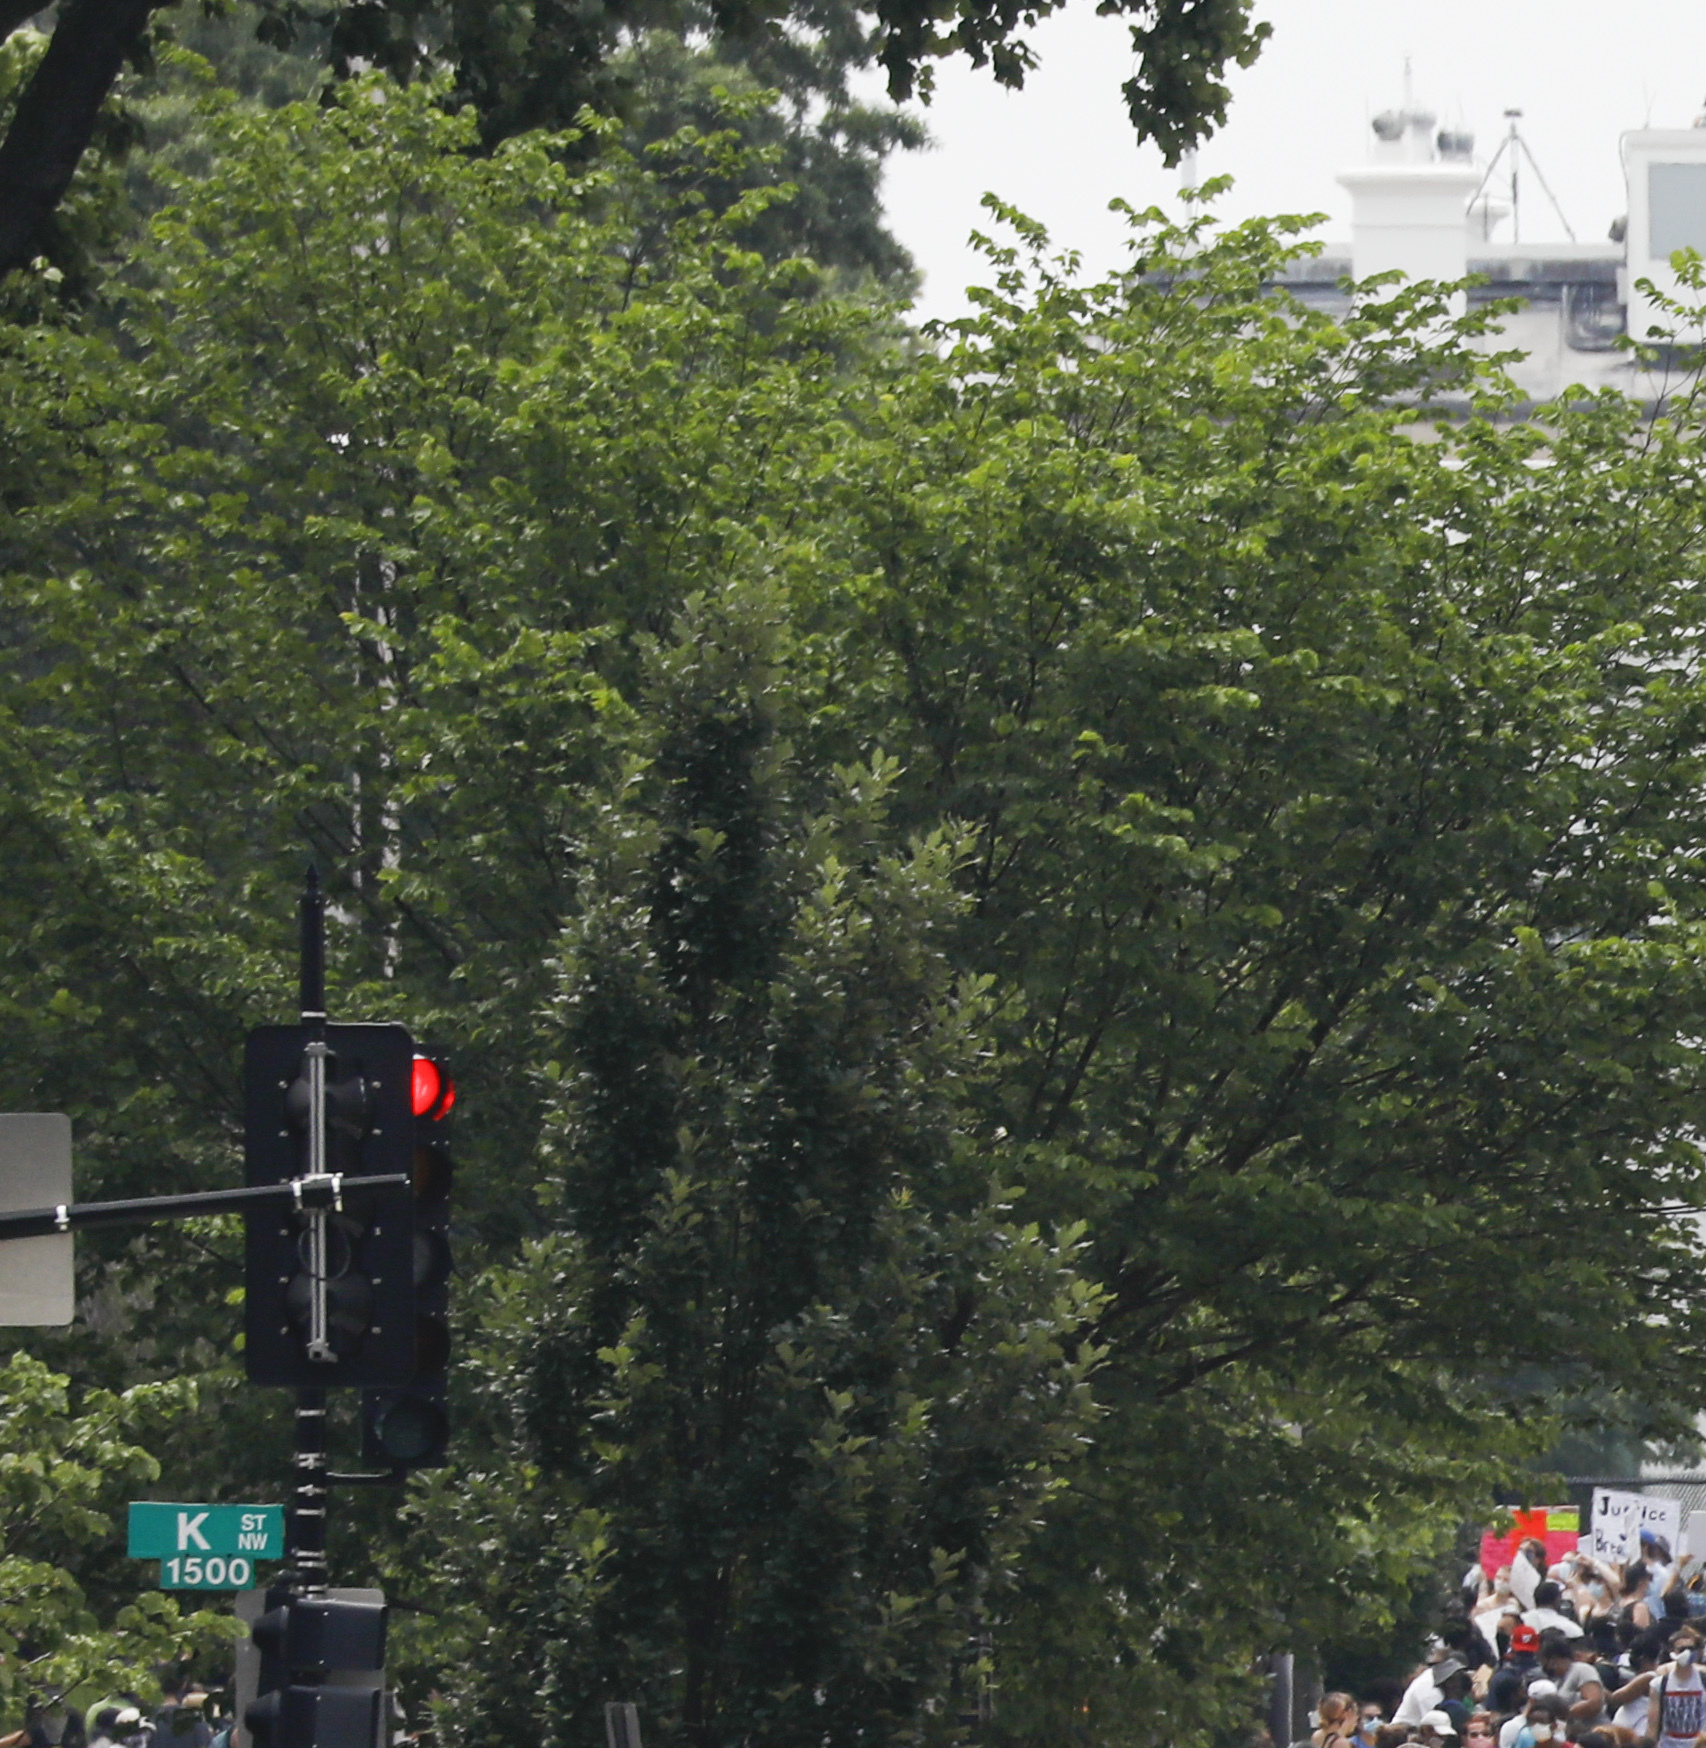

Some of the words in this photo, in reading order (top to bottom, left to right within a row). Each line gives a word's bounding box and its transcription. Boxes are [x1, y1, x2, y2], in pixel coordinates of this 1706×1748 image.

[178, 1512, 212, 1550] K
[241, 1514, 267, 1531] ST
[238, 1533, 268, 1550] NW
[167, 1557, 249, 1586] 1500
